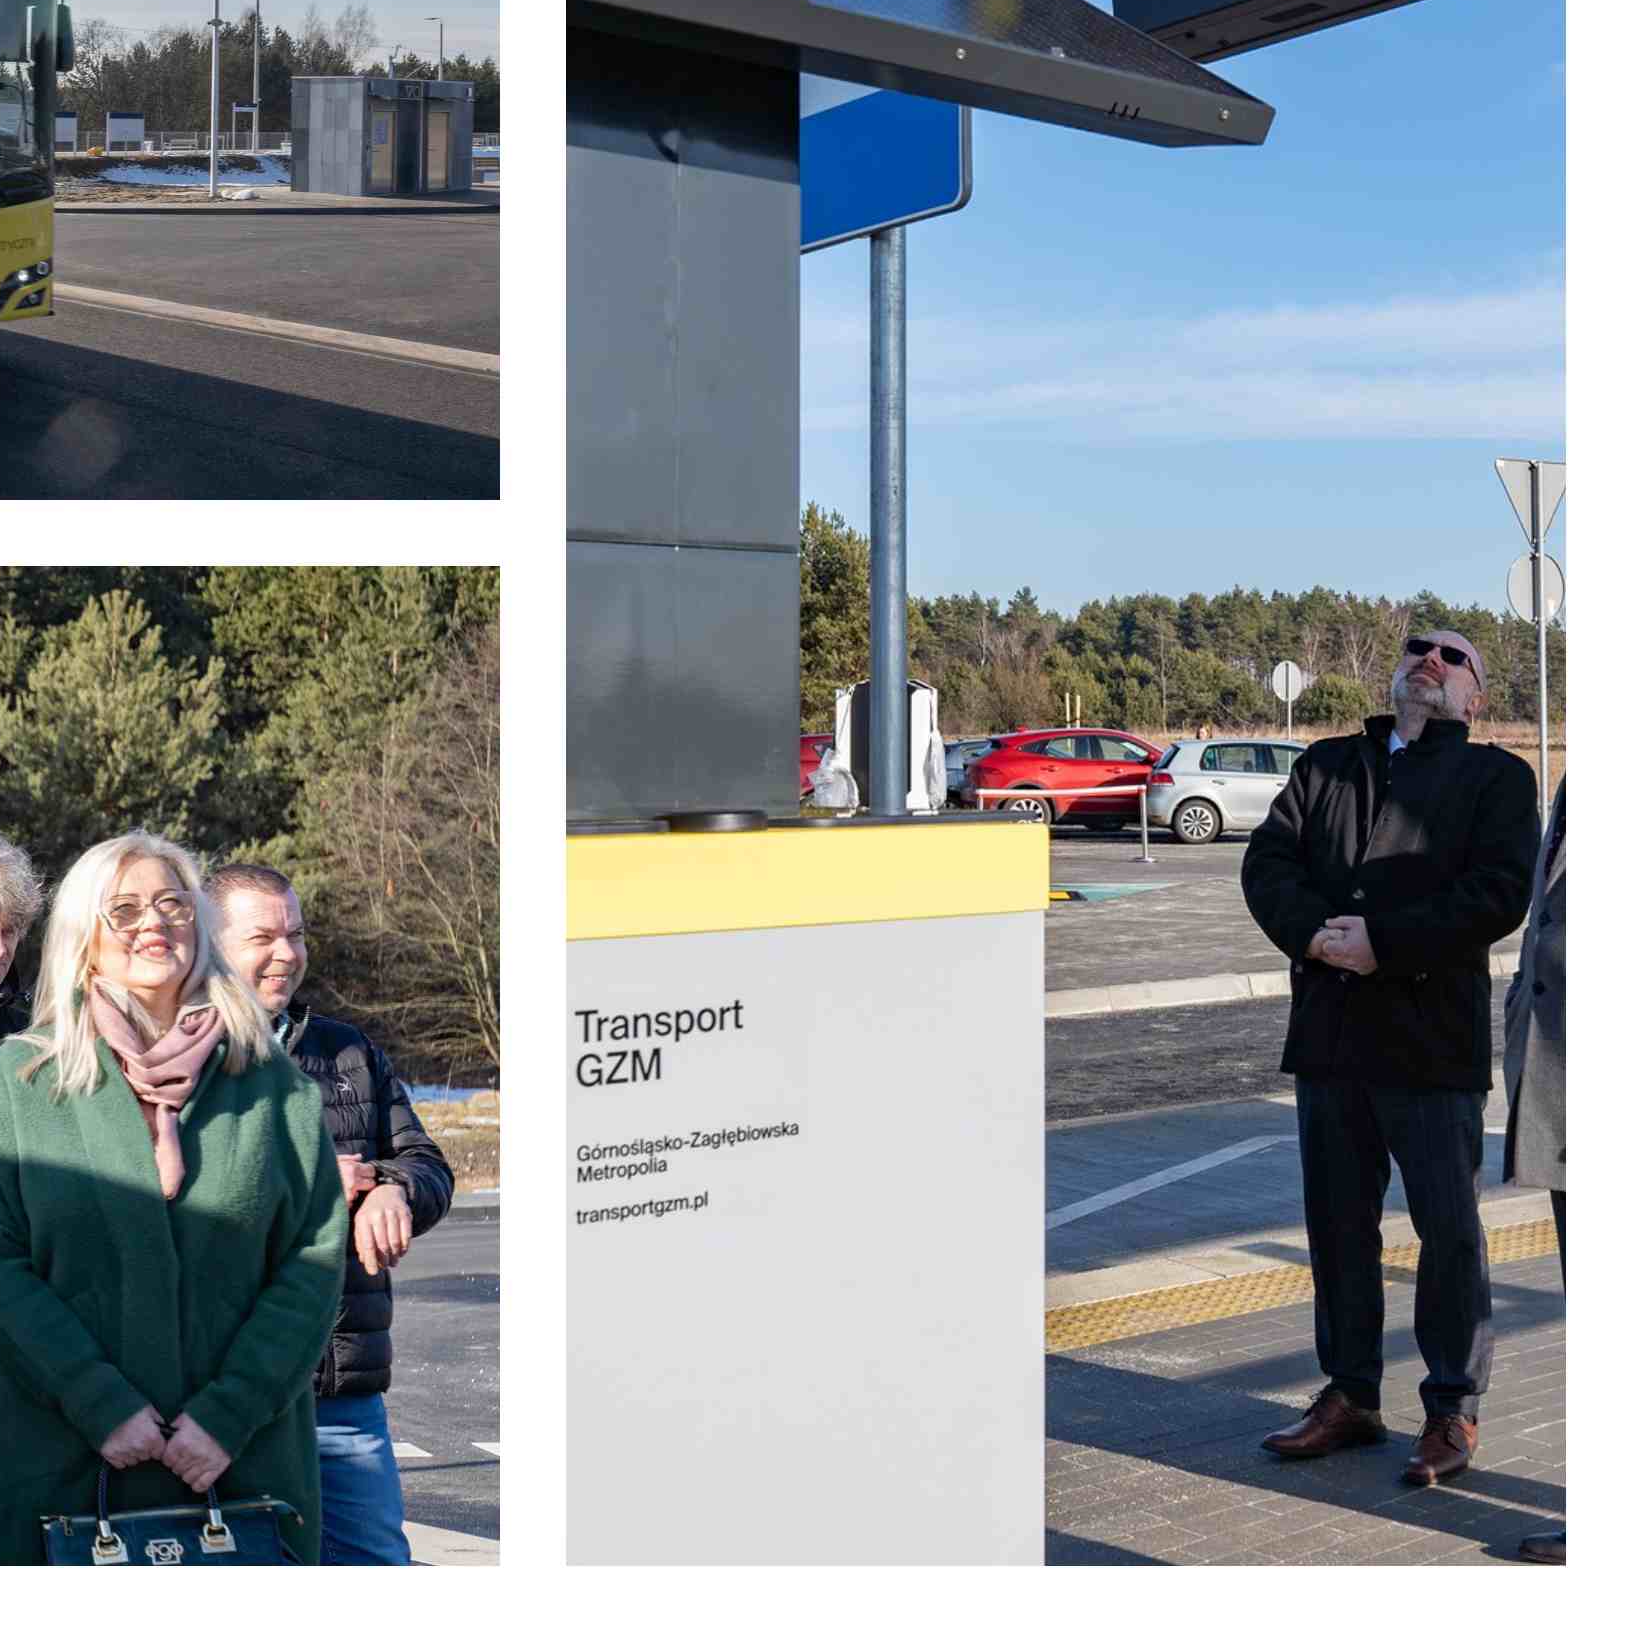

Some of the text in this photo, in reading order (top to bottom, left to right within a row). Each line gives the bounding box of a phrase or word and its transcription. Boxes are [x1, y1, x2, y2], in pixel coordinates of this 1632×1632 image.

[575, 1000, 745, 1042] Transport
[575, 1047, 662, 1087] GZM
[576, 1120, 800, 1163] Górnośląsko-Zagłębiowska
[576, 1156, 669, 1184] Metropolia
[576, 1191, 709, 1225] transportgzm.pl
